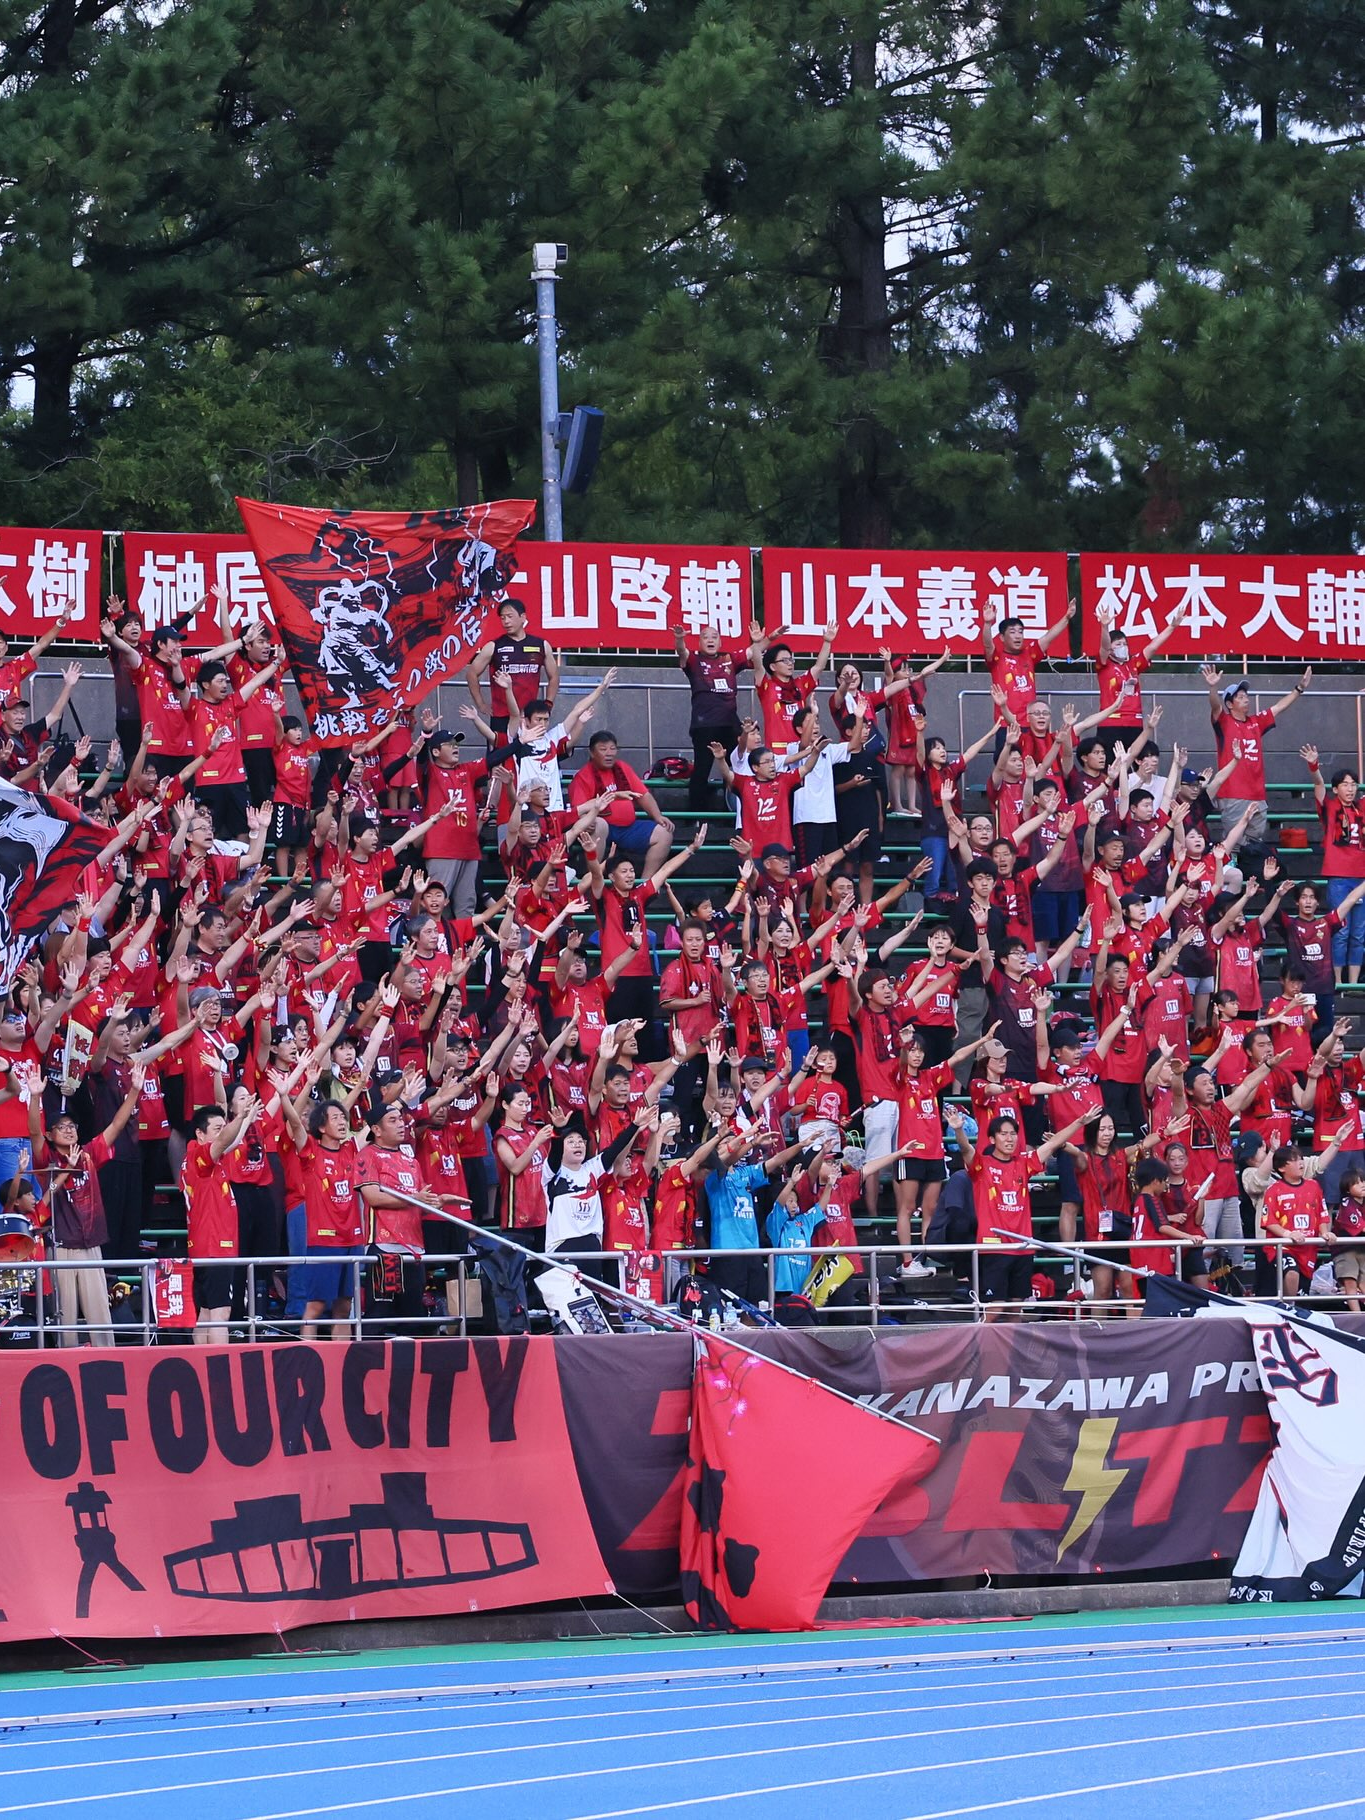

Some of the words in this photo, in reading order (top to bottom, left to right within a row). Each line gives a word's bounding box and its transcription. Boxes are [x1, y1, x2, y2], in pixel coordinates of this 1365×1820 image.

[511, 555, 743, 639] 山啓輔
[780, 563, 1049, 641] 山本義道
[1095, 564, 1365, 645] 松本大輔
[757, 797, 778, 816] 12
[20, 1359, 130, 1480] OF
[147, 1345, 332, 1475] OUR
[342, 1336, 528, 1450] CITY
[856, 1372, 1168, 1420] KANAZAWA
[1343, 1506, 1365, 1569] PIRIT
